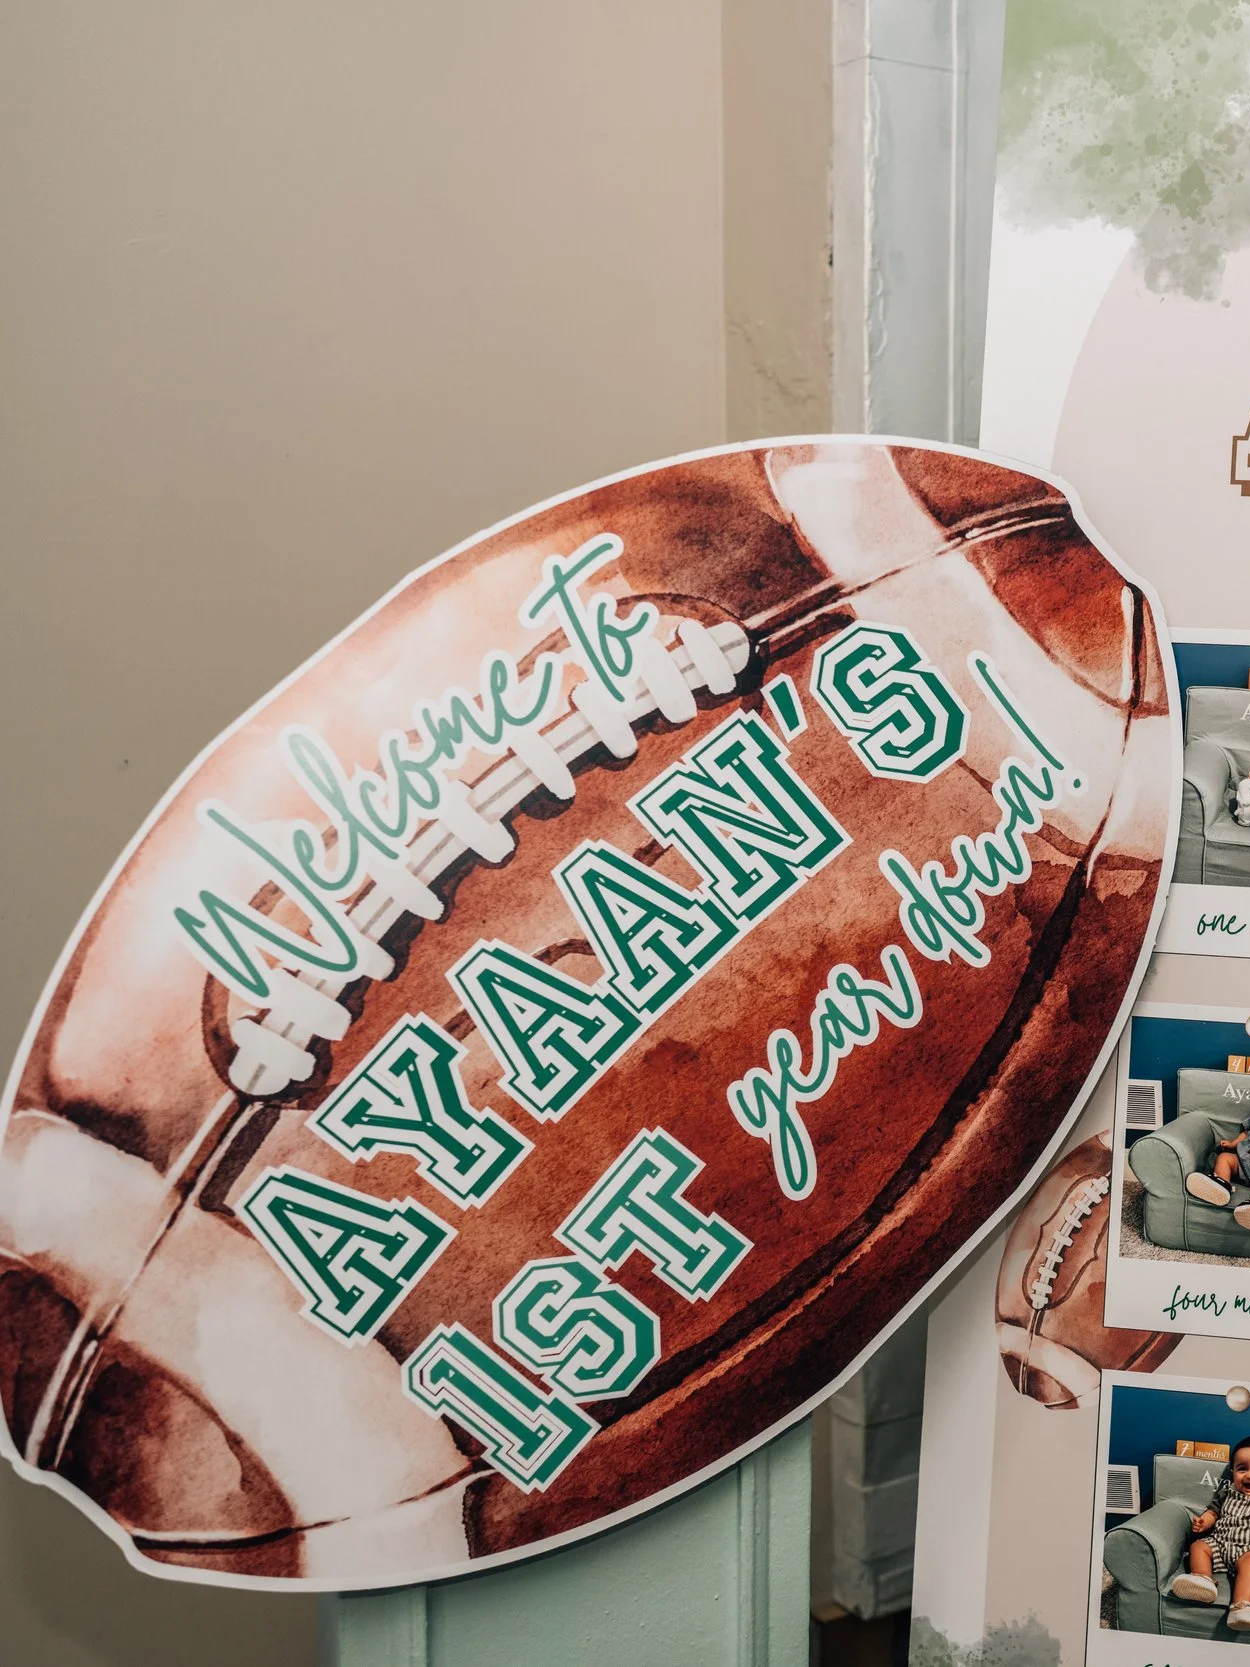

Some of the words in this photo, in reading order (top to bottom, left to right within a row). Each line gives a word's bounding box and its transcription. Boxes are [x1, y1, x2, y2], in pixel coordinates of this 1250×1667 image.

[174, 659, 554, 998] Welcome
[528, 542, 652, 703] to
[1197, 913, 1247, 936] one
[238, 618, 970, 1343] AYAAN'S
[405, 1128, 751, 1490] 1ST
[736, 952, 914, 1193] year
[886, 657, 1083, 961] down!
[1163, 1285, 1227, 1321] four
[1180, 1443, 1191, 1457] 7
[1196, 1448, 1226, 1460] months
[1200, 1470, 1232, 1492] Aya
